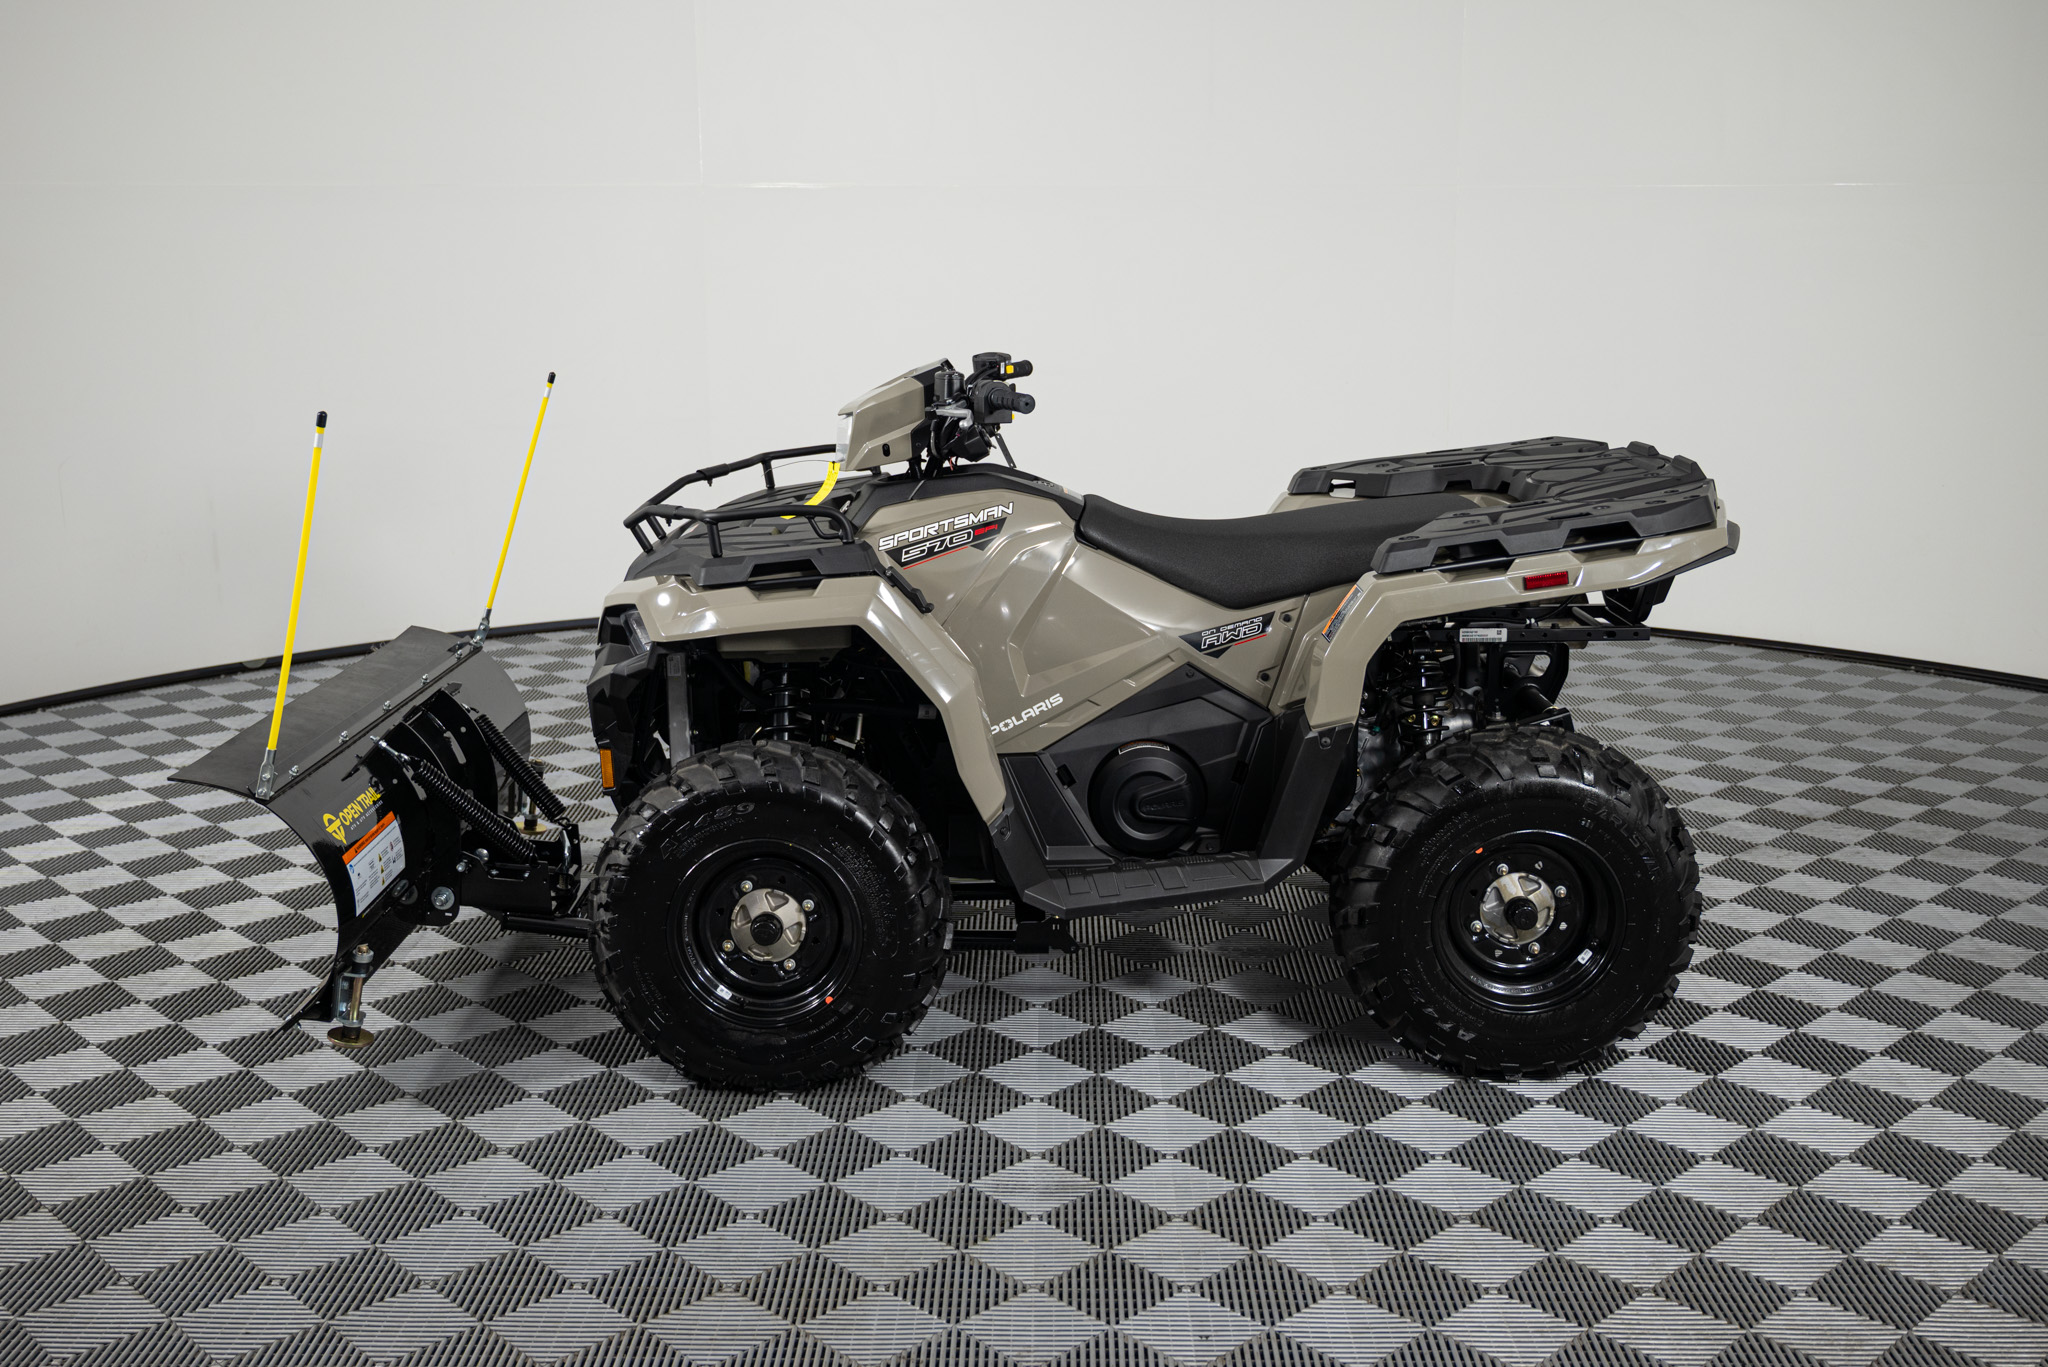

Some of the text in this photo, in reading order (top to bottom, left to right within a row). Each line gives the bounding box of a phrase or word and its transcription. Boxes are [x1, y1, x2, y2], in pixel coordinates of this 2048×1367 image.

[878, 502, 1015, 551] SPORTSMAN
[901, 529, 973, 562] 570
[1200, 622, 1263, 649] AWD
[990, 692, 1064, 735] POLARIS
[338, 786, 381, 826] OPEN TRAIL
